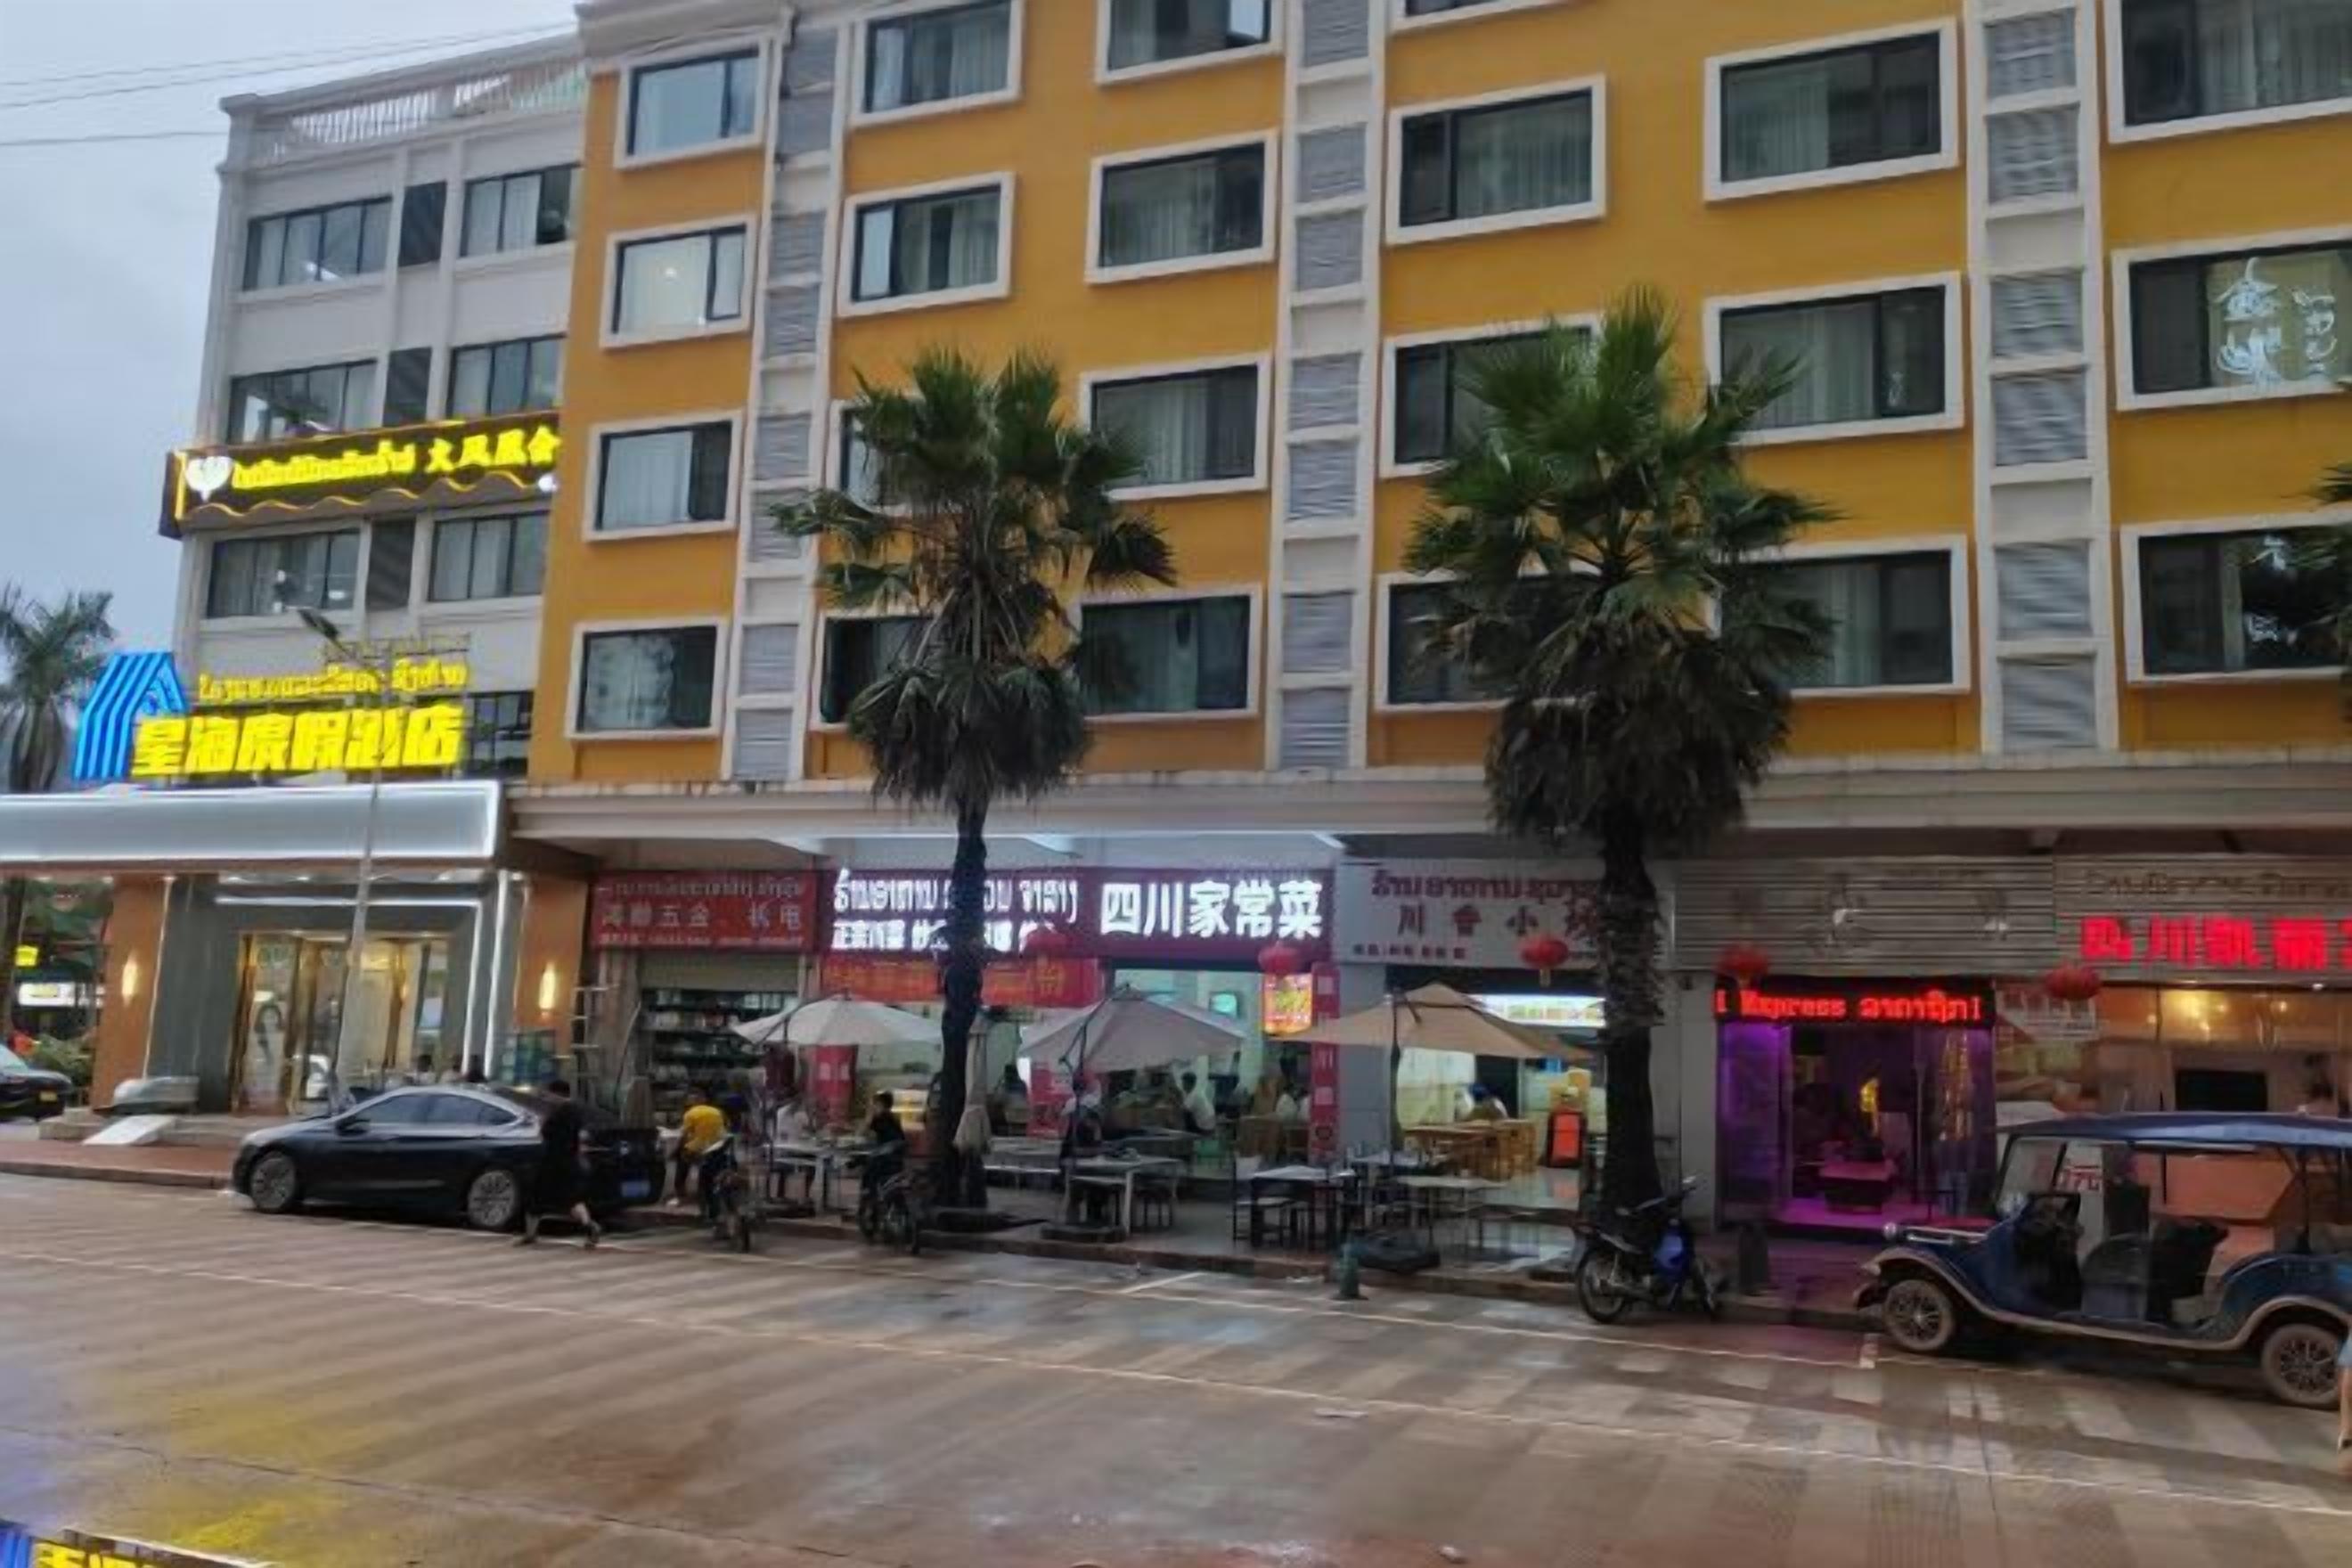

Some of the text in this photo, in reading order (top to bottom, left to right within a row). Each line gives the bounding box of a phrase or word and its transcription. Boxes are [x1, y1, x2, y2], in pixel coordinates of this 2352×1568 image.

[1100, 879, 1323, 938] 四川家常菜
